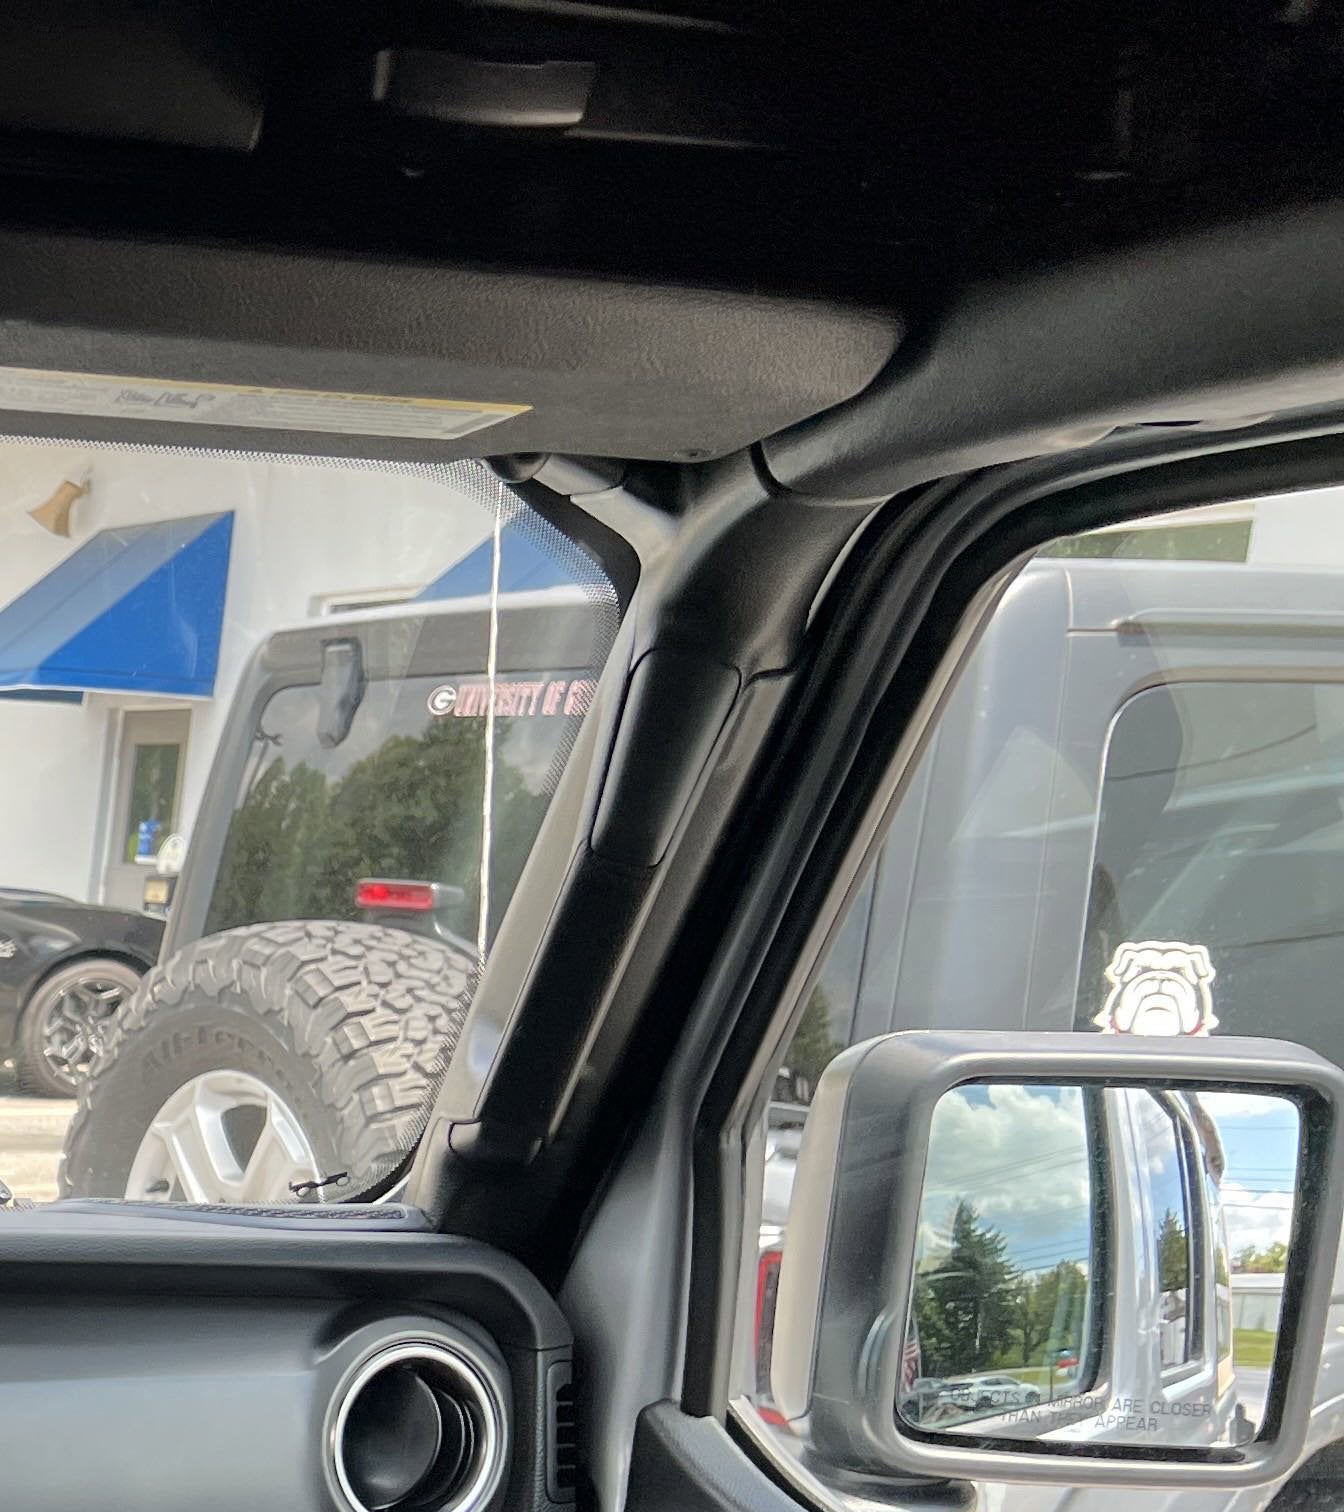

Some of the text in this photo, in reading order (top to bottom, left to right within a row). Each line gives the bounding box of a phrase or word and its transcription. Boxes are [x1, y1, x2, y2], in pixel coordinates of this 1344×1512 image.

[1112, 1399, 1142, 1415] ARE
[1149, 1401, 1211, 1417] CLOSER
[1093, 1414, 1159, 1431] APPEAR
